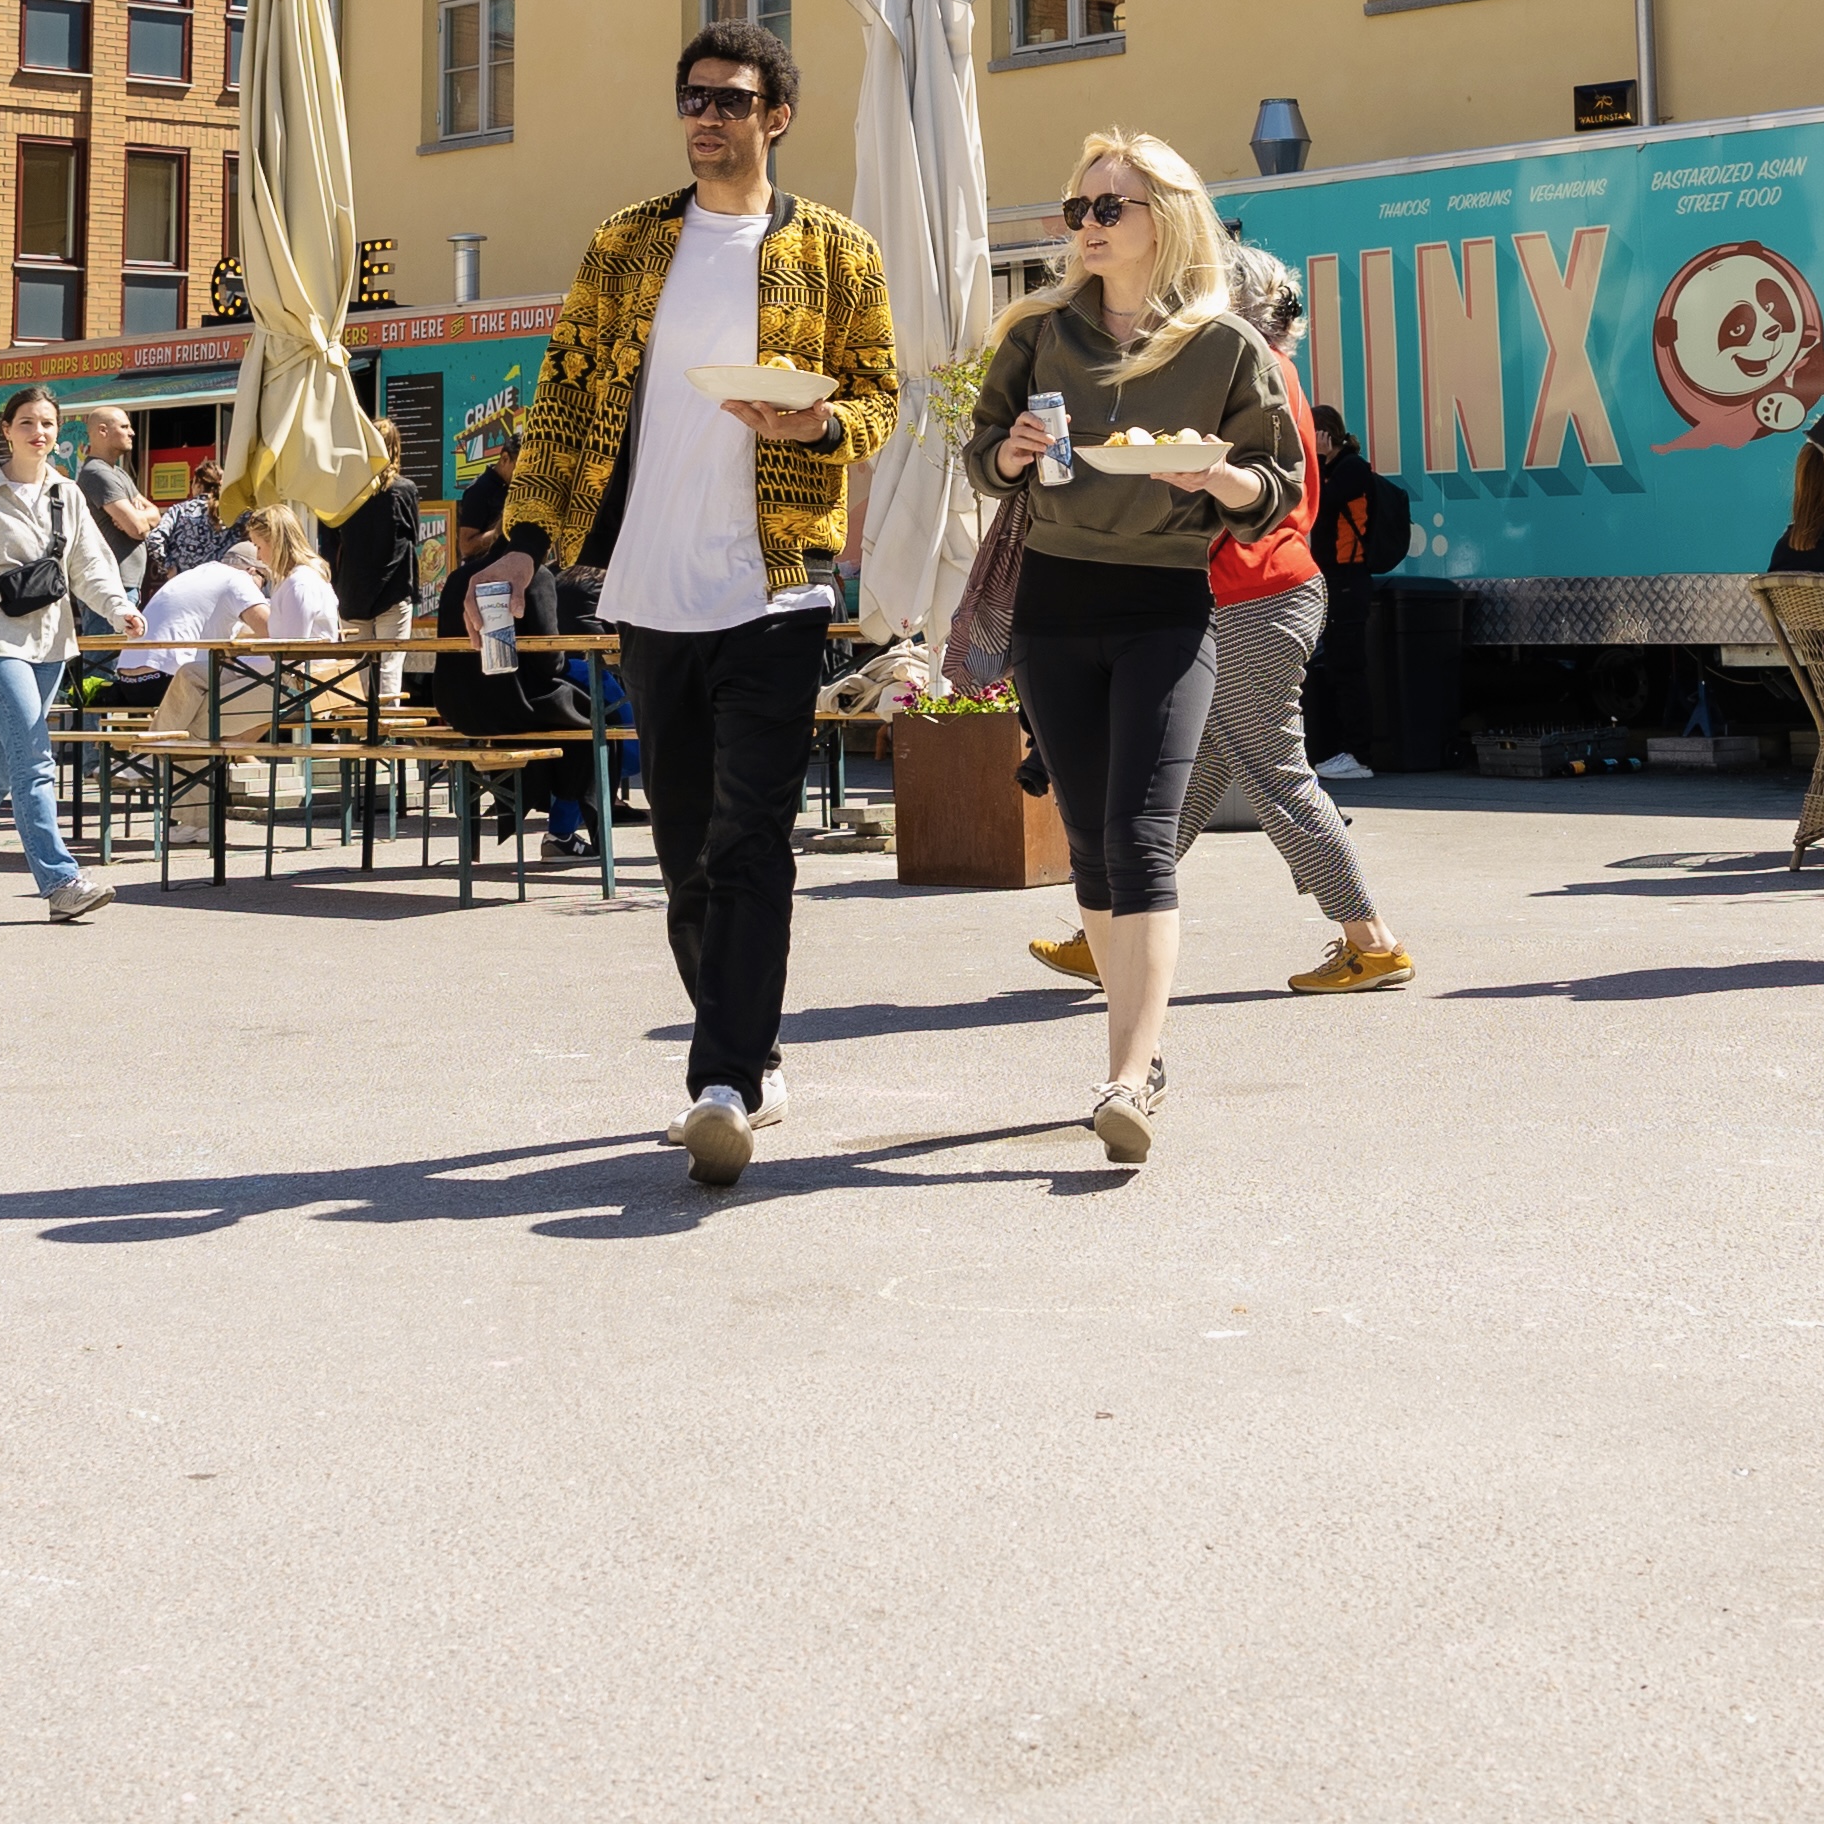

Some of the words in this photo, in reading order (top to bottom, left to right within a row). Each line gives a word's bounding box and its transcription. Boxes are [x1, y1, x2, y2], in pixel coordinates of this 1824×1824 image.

[1651, 163, 1754, 191] BASTARDIZED
[1757, 156, 1808, 179] ASIAN
[1379, 199, 1431, 220] THAICOS
[1447, 189, 1513, 212] PORKBUNS
[1529, 178, 1608, 203] VEGANBUNS
[1675, 191, 1729, 215] STREET
[1736, 186, 1783, 209] FOOD
[381, 321, 407, 343] EAT
[411, 318, 445, 340] HERE
[470, 312, 506, 335] TAKE
[510, 307, 555, 329] AWAY
[40, 357, 79, 376] WRAPS
[82, 356, 90, 371] &
[93, 351, 123, 371] DOGS
[134, 346, 172, 366] VEGAN
[175, 340, 231, 363] FRIENDLY
[465, 385, 514, 430] CRAVE
[418, 519, 446, 542] RLIN
